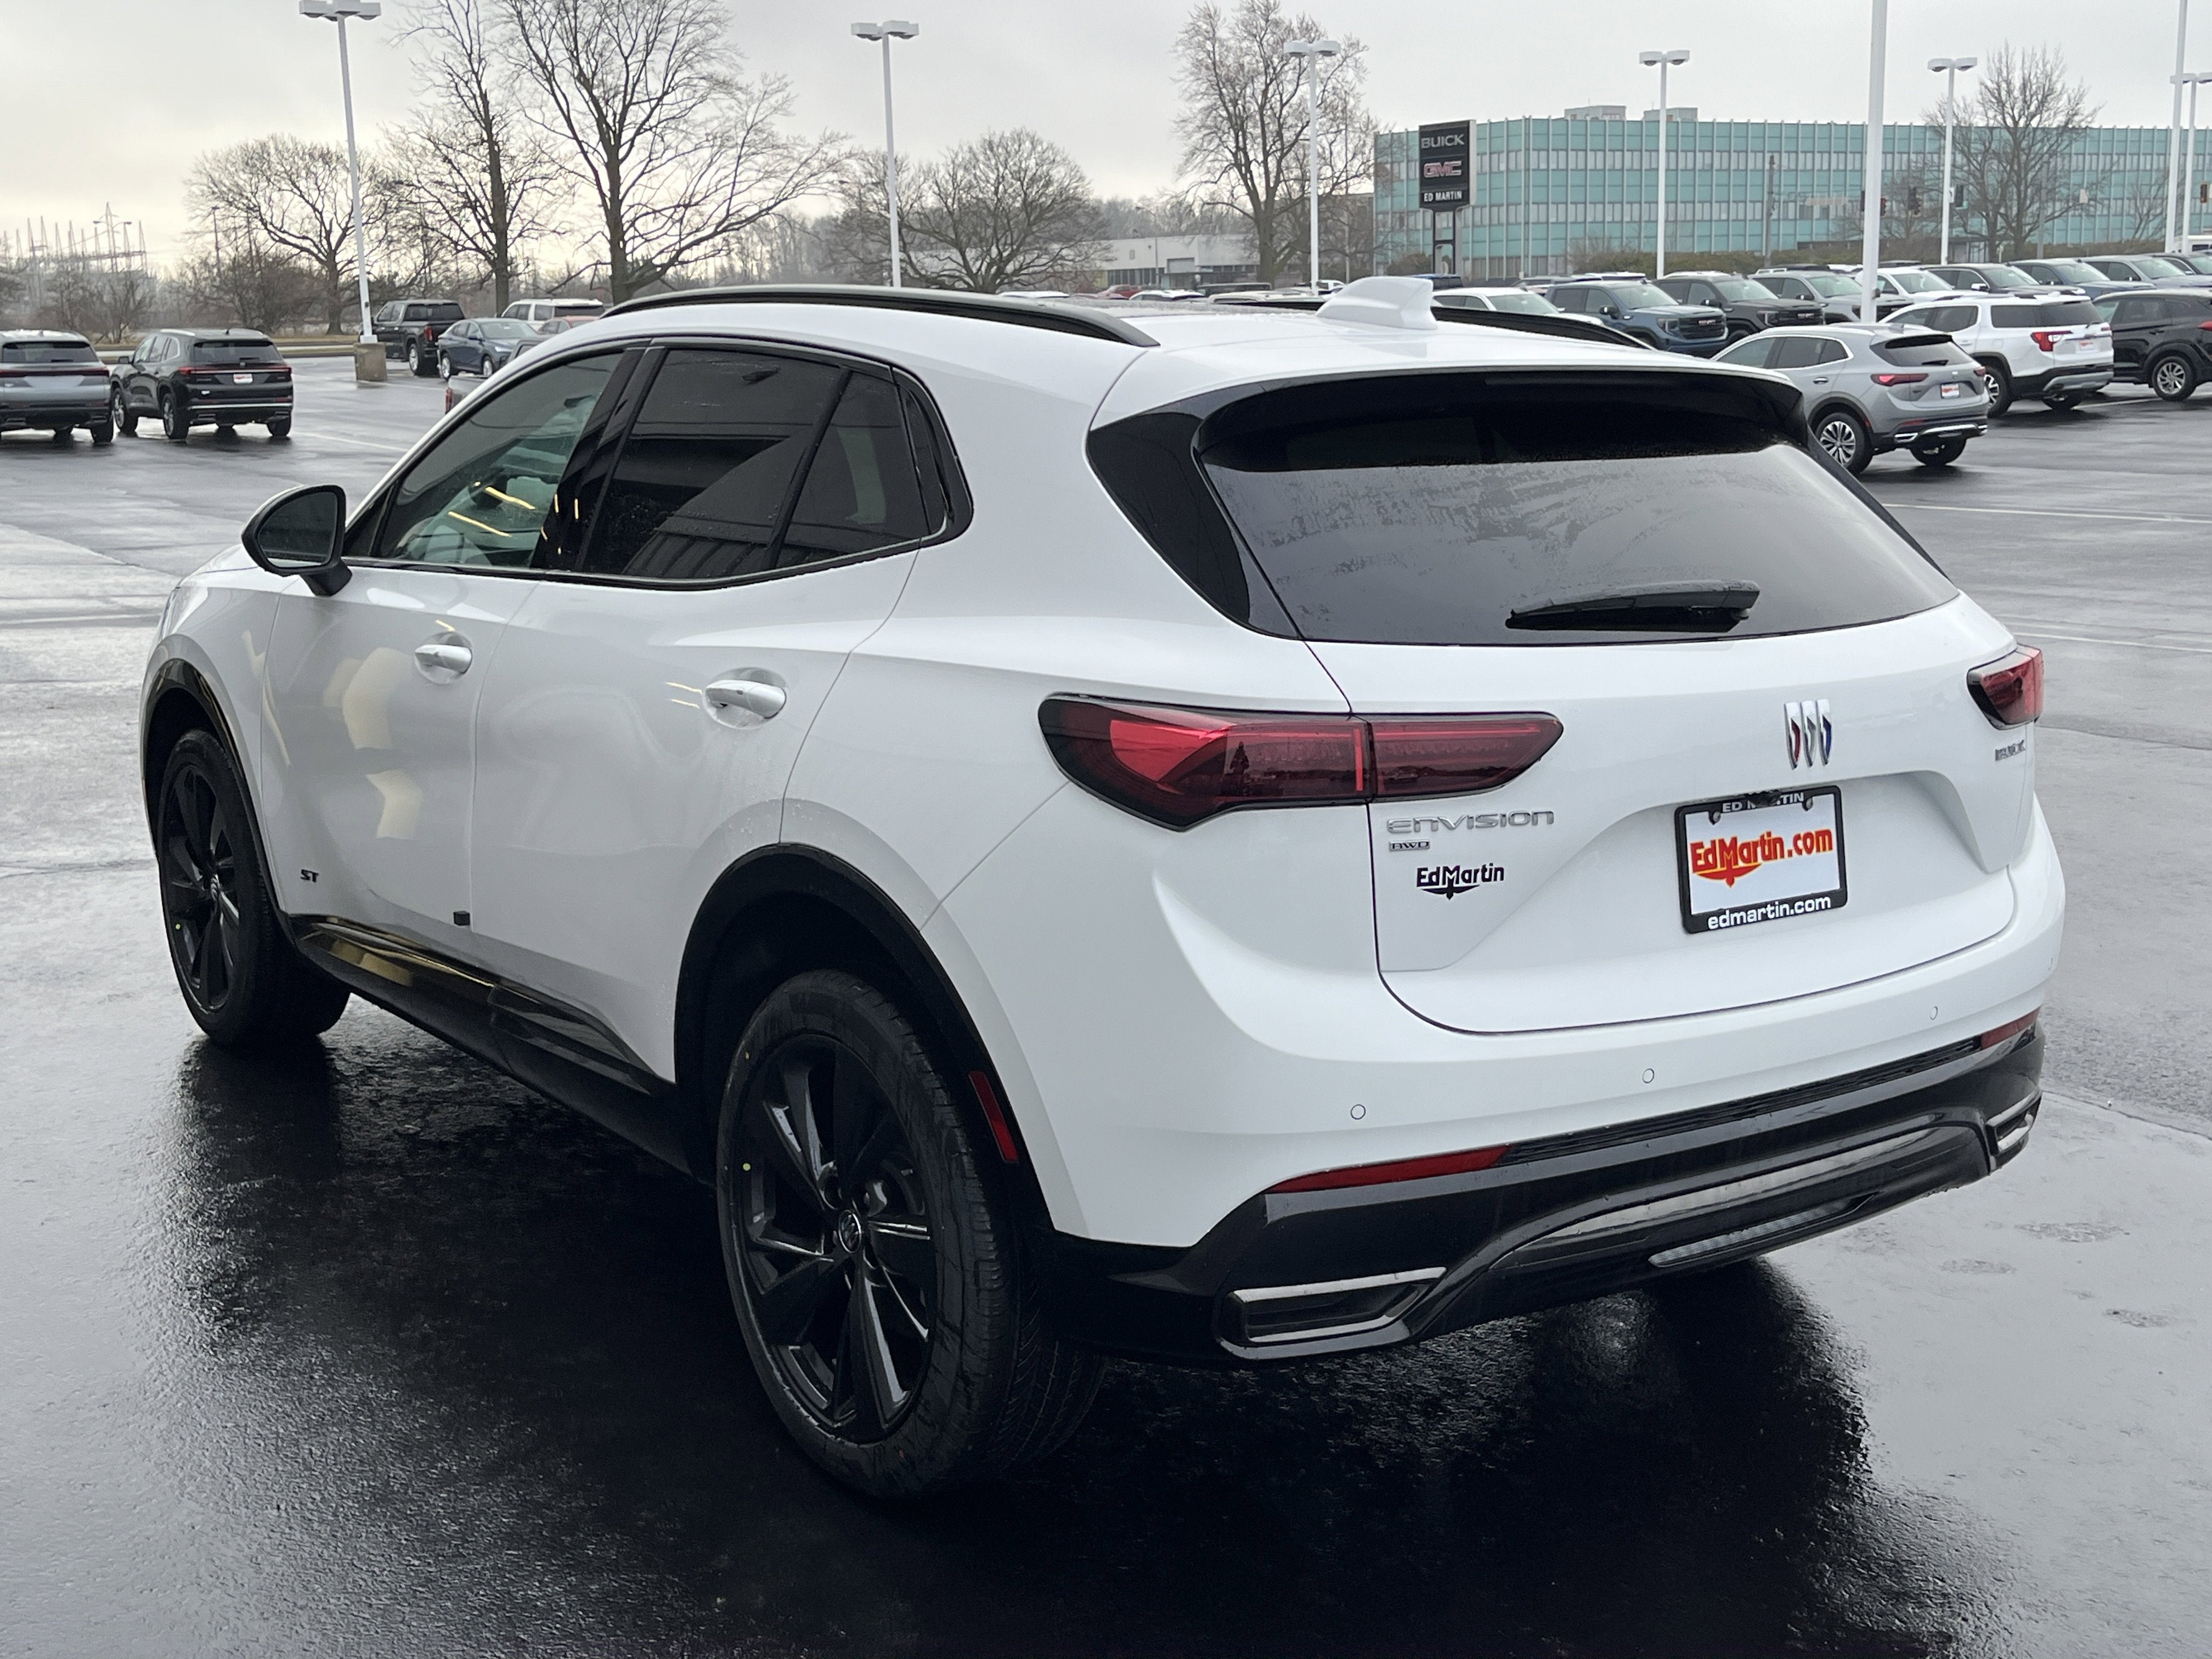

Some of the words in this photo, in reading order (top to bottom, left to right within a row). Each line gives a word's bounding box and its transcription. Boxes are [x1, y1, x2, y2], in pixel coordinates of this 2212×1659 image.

[1421, 134, 1464, 149] BUICK
[1424, 161, 1462, 178] GMC
[1424, 193, 1433, 202] ED
[1435, 191, 1462, 201] MARTIN
[1722, 802, 1742, 812] ED
[1387, 811, 1554, 833] ENVISION
[1391, 841, 1430, 850] AWD
[300, 870, 319, 882] ST
[1708, 896, 1831, 929] edmartin.com
